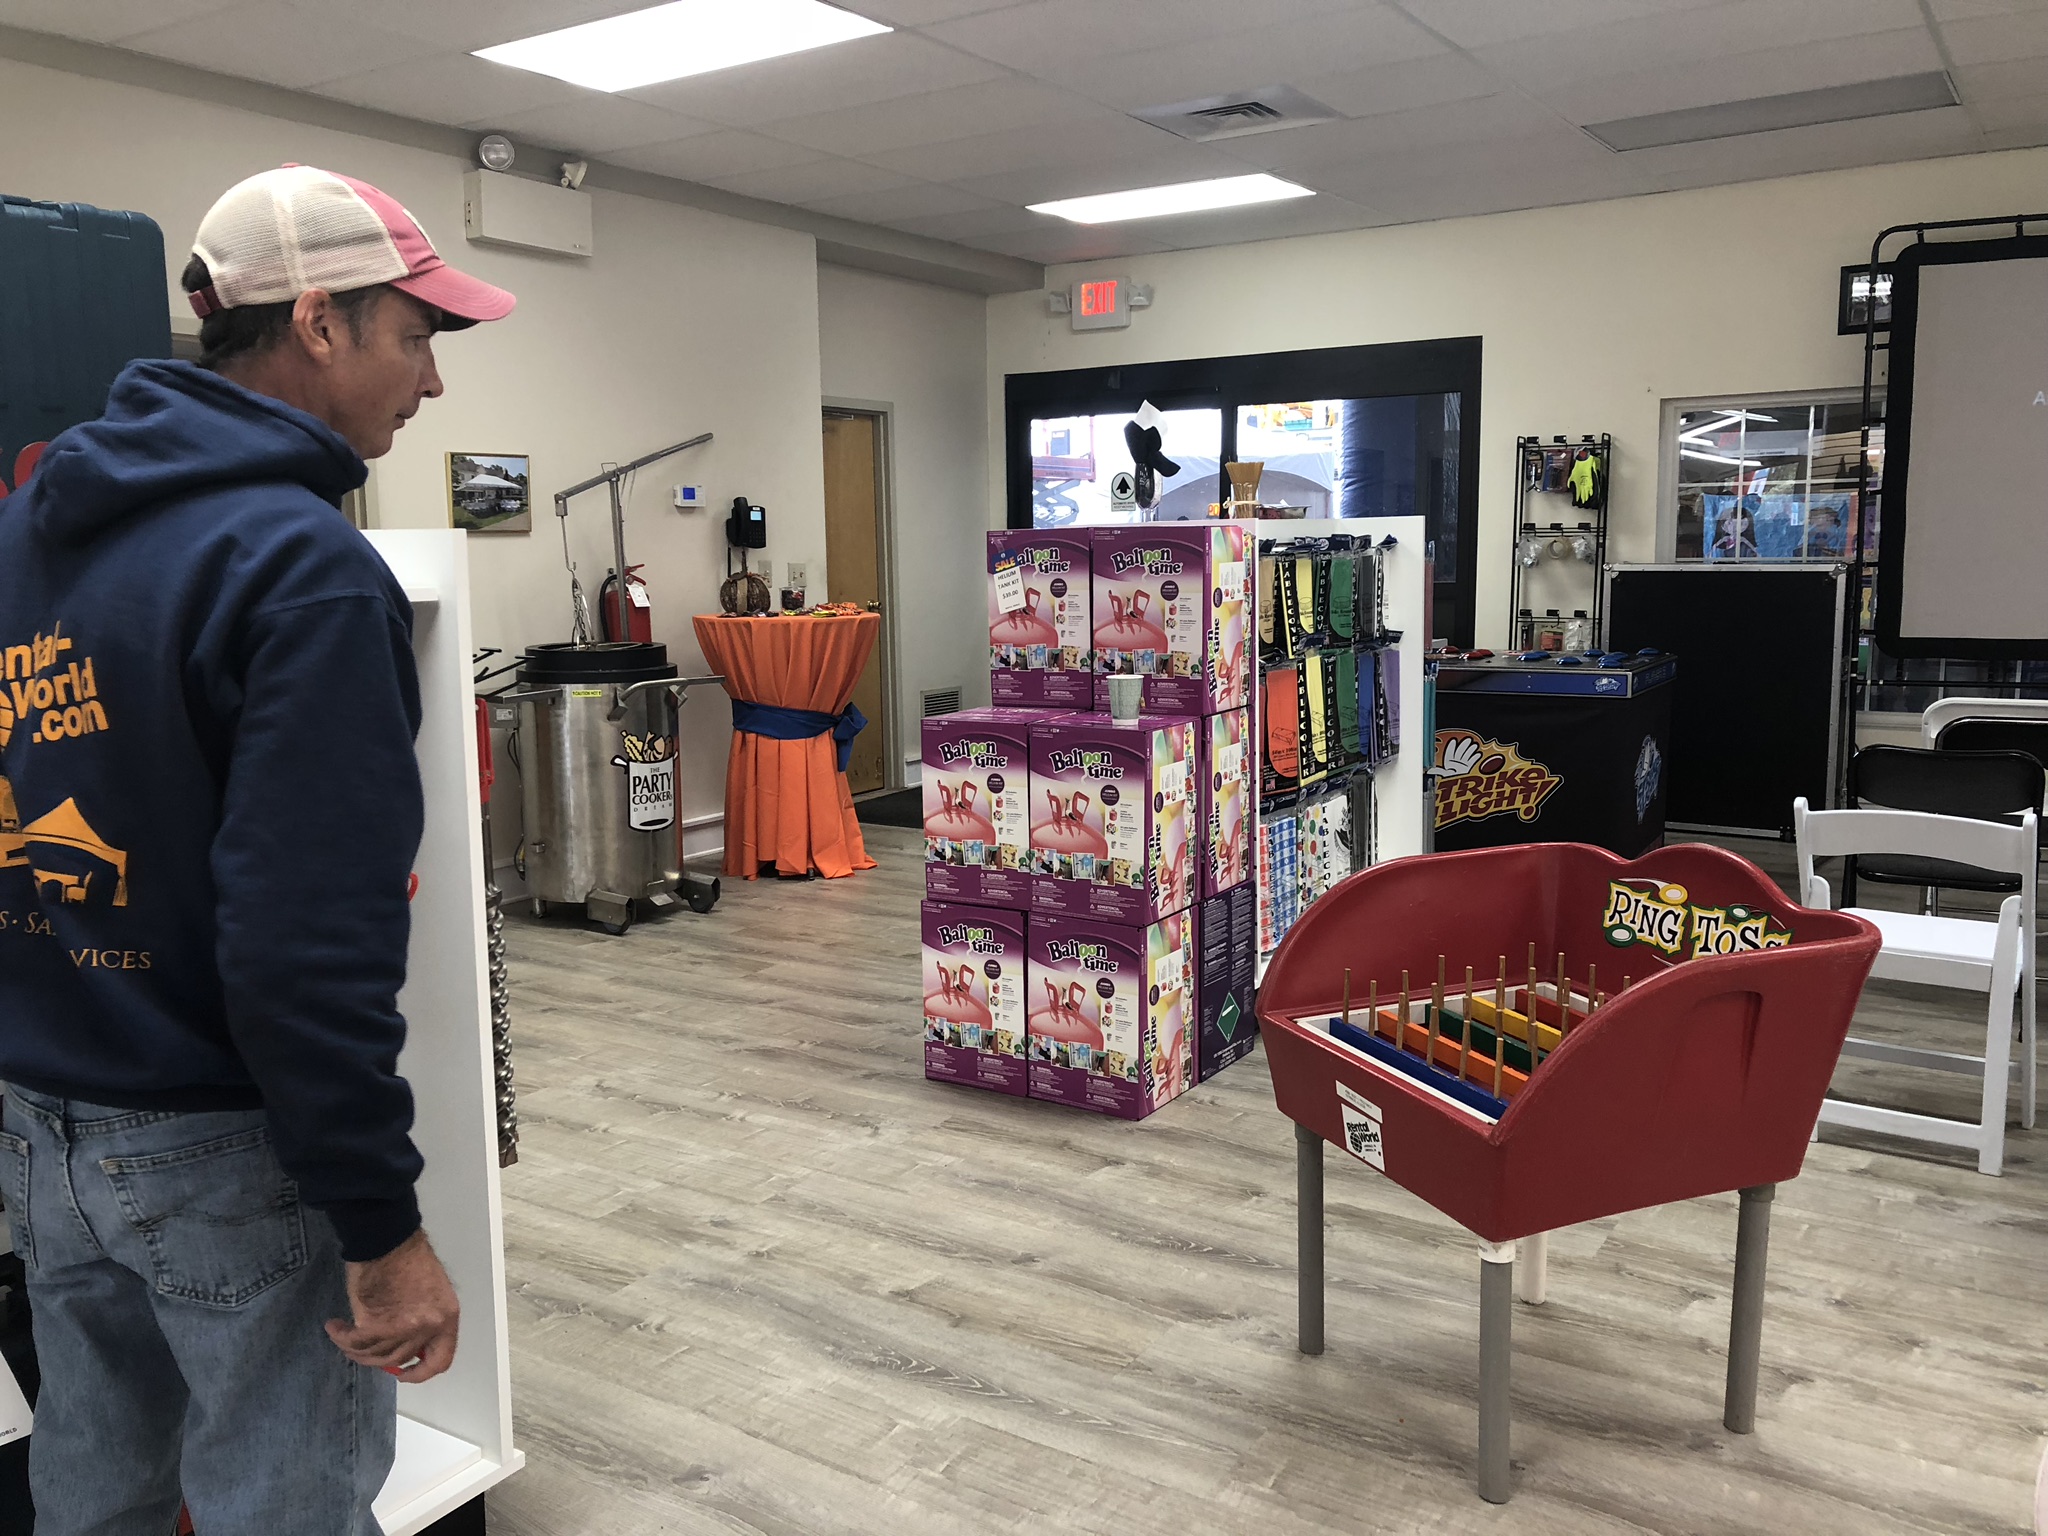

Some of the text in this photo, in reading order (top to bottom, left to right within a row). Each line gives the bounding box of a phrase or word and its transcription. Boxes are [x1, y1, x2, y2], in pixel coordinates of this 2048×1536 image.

[1081, 280, 1118, 316] EXIT
[2032, 390, 2048, 406] A
[995, 556, 1016, 572] SALE
[1018, 547, 1059, 566] alloon
[1111, 548, 1172, 573] Balloon
[997, 570, 1017, 580] HELIUM
[1038, 559, 1070, 575] time
[1148, 561, 1181, 576] time
[998, 578, 1019, 590] TANK KIT
[1316, 560, 1328, 630] TABLECOV
[1297, 663, 1310, 777] TABLECOVER
[1326, 664, 1337, 771] TABLECOVER
[939, 740, 996, 763] Balloon
[974, 752, 1007, 768] time
[1050, 748, 1112, 772] Balloon
[650, 766, 660, 774] THE
[1087, 763, 1122, 779] time
[632, 771, 673, 795] PARTY
[1322, 805, 1332, 892] TABLECOV
[1608, 890, 1682, 946] RING
[938, 924, 993, 946] Balloon
[972, 938, 1004, 956] time
[1047, 939, 1107, 962] Balloon
[69, 949, 152, 969] VICES
[1083, 955, 1118, 973] time
[1346, 1122, 1370, 1133] Rental
[1360, 1132, 1380, 1143] World
[0, 1427, 18, 1438] ORLD
